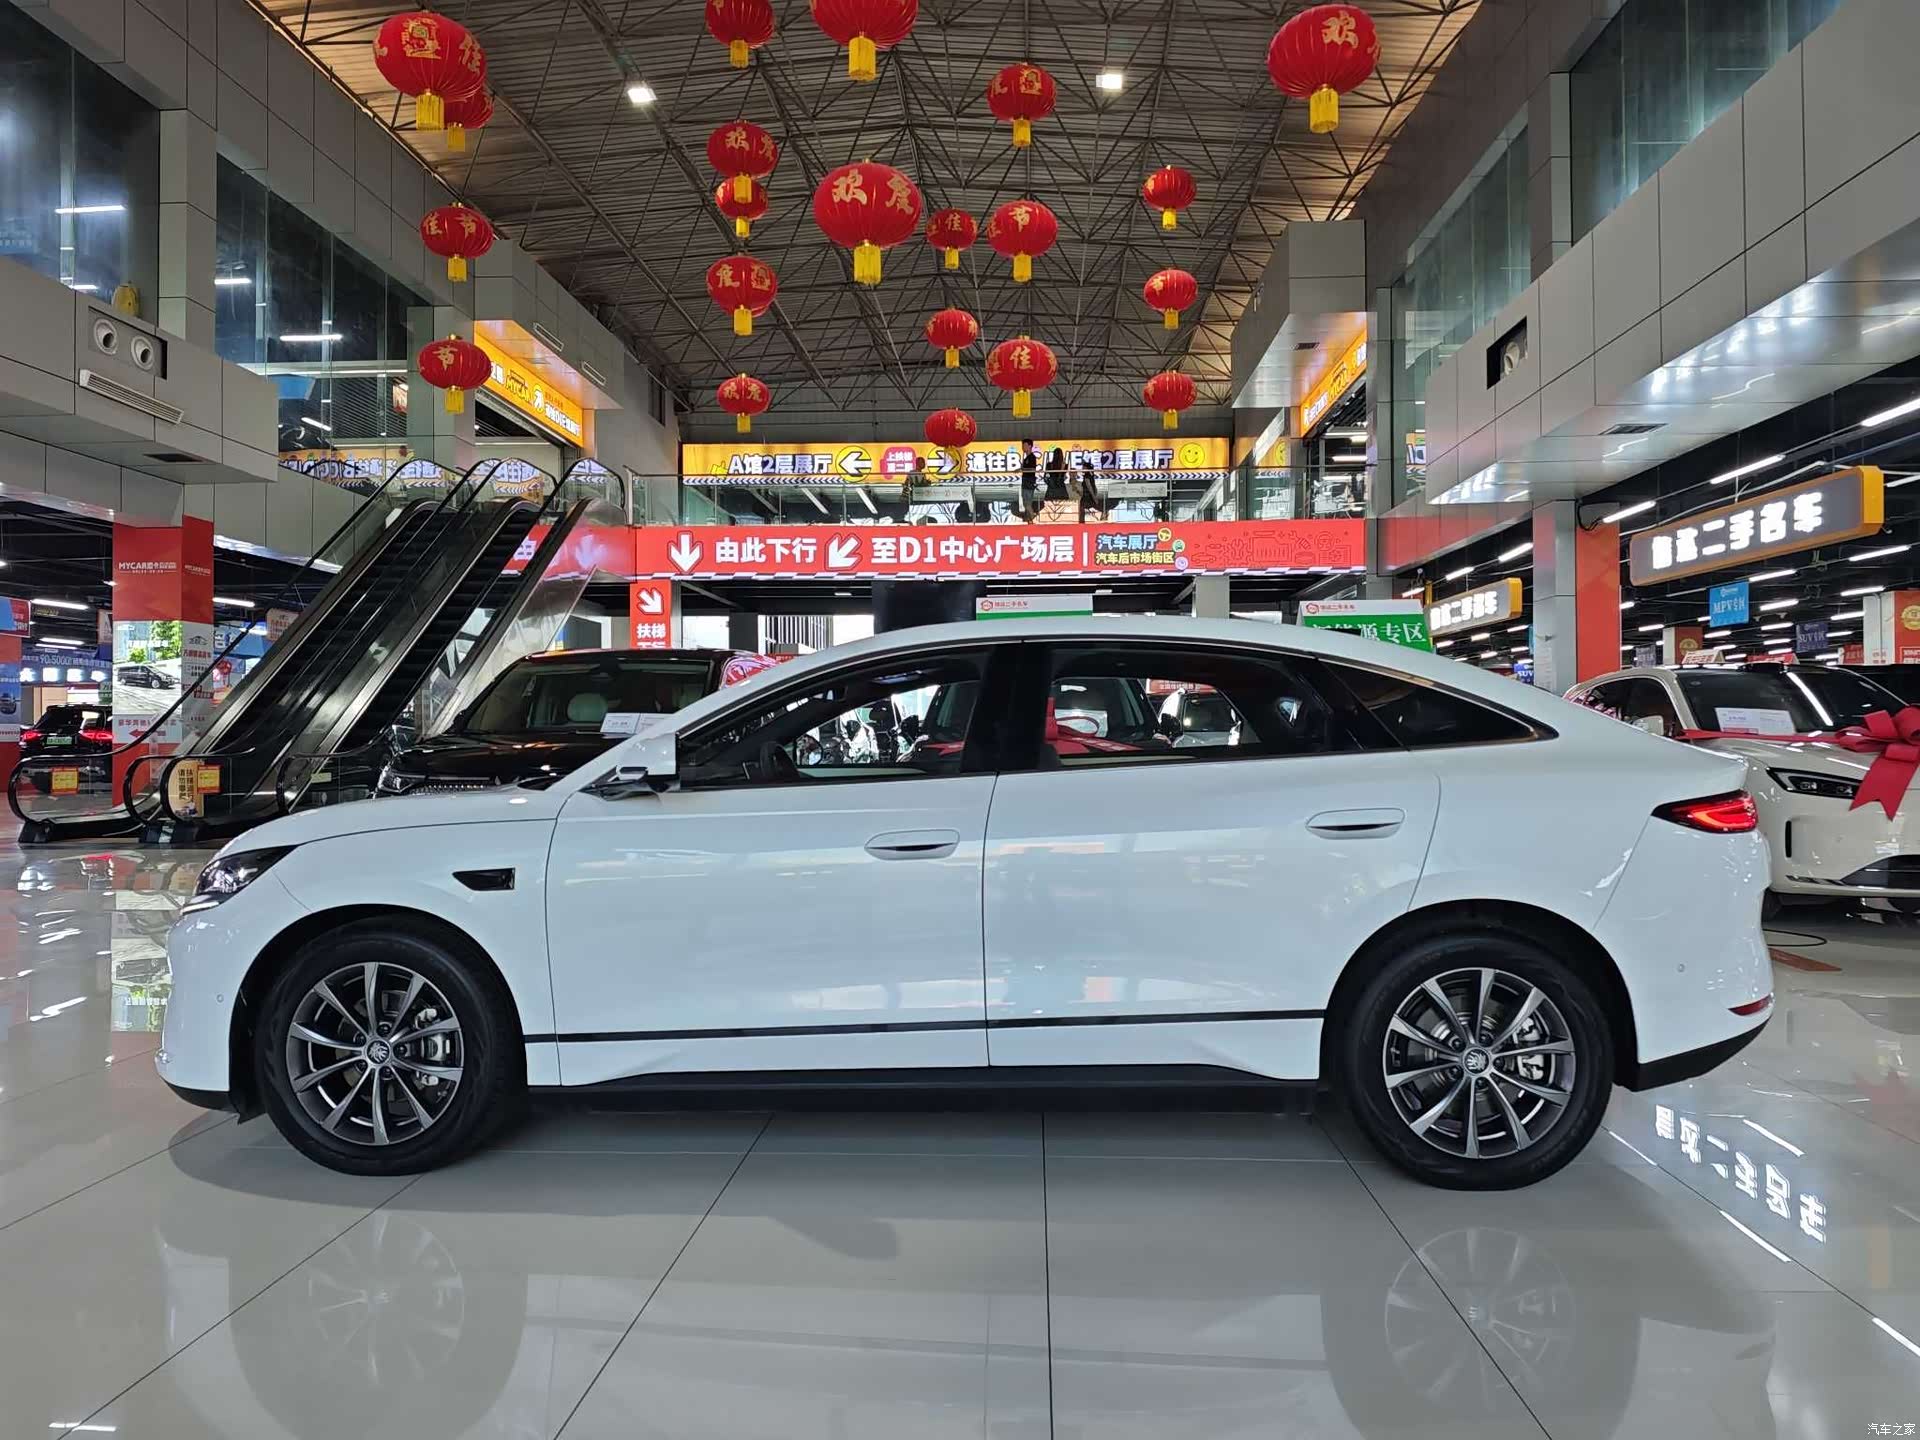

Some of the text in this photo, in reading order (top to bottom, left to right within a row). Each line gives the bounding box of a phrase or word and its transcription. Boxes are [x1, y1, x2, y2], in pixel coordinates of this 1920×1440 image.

[729, 453, 832, 475] A馆2层展厅
[715, 536, 817, 564] 由此下行
[871, 535, 1075, 564] 至D1中心广场层
[1097, 534, 1158, 550] 汽车展厅
[1095, 551, 1175, 564] 汽车后市场街区
[636, 622, 667, 640] 扶梯
